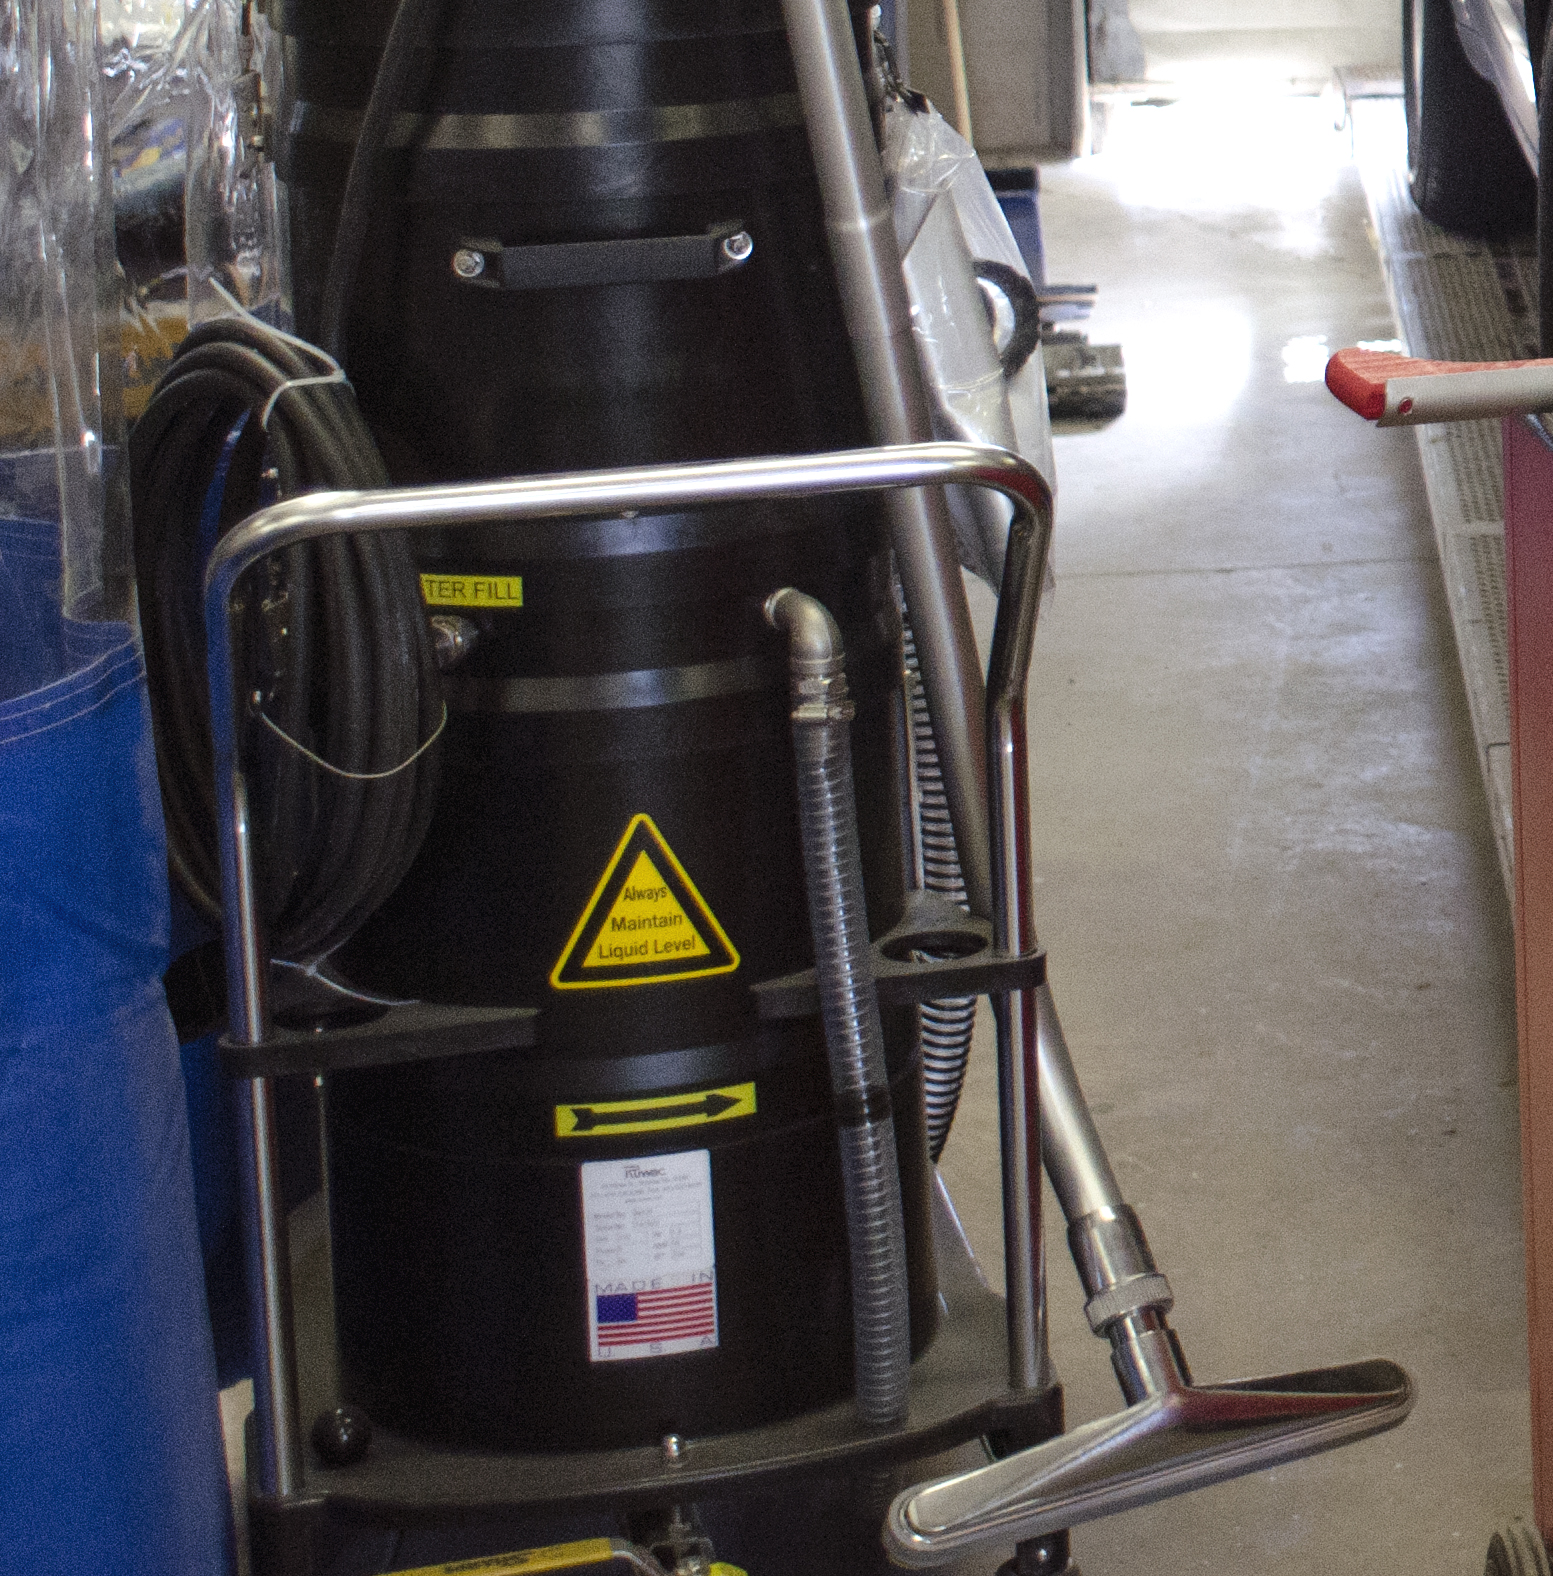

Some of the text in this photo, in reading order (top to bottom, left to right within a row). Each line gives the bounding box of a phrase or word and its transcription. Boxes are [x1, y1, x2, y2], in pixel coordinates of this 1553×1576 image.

[473, 581, 520, 600] FILL
[623, 885, 668, 903] Always
[611, 911, 683, 932] Maintain
[598, 934, 696, 960] Liquid Level
[594, 1270, 714, 1294] MADE IN
